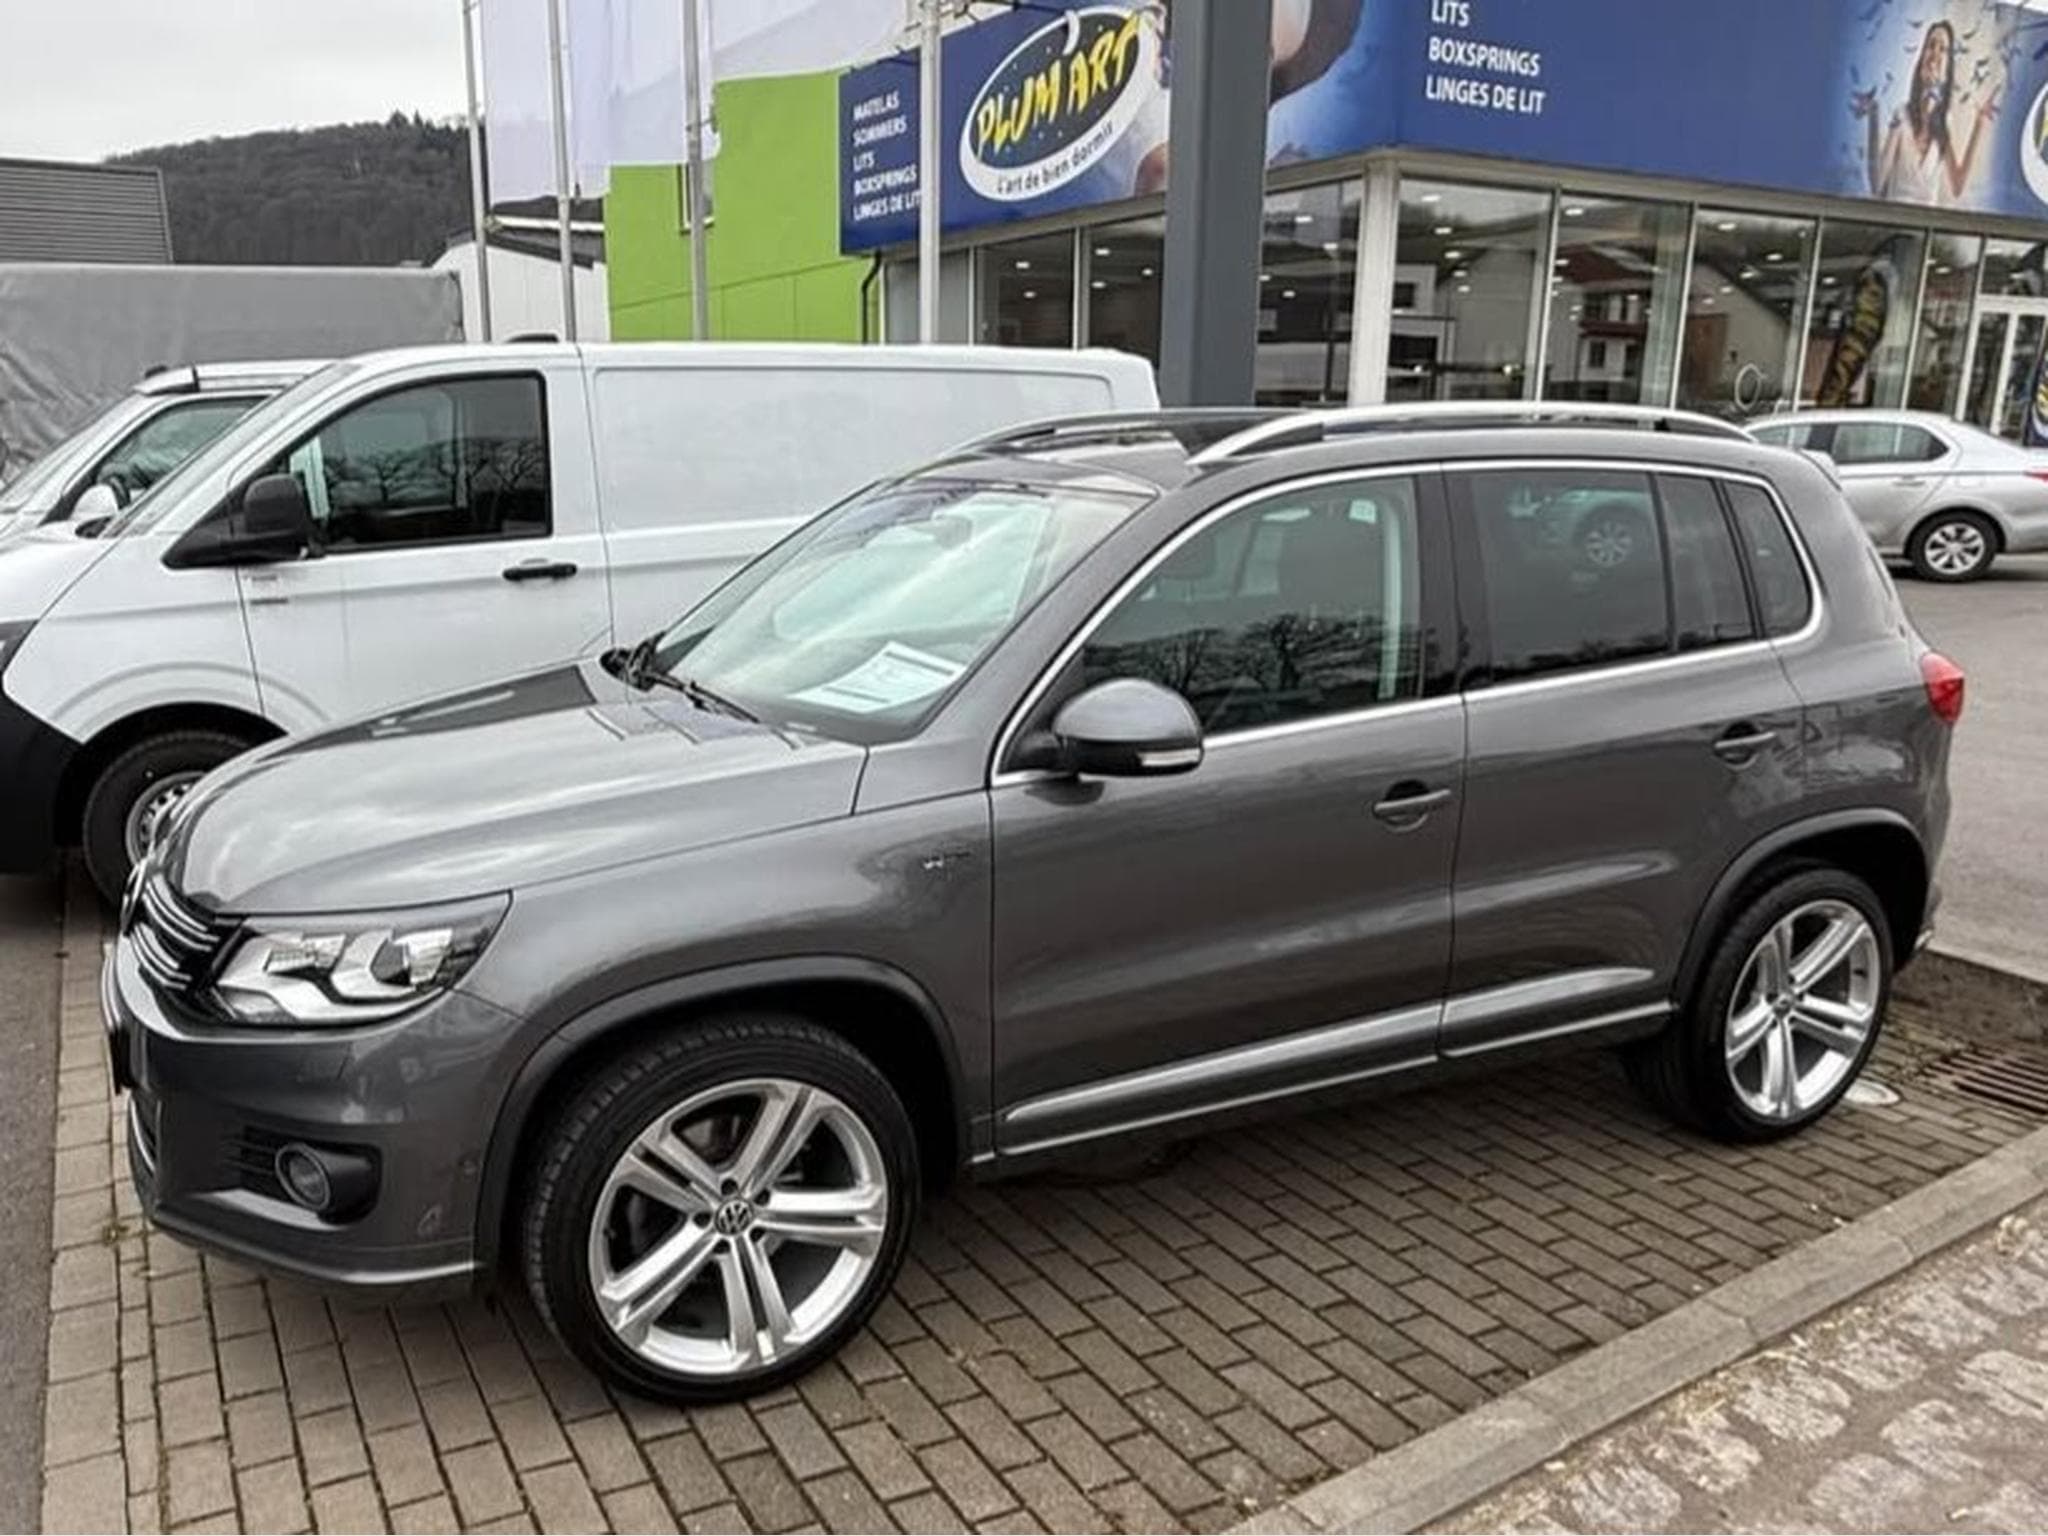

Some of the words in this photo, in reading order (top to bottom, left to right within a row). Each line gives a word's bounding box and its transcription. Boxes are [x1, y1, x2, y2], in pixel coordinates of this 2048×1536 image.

[1431, 0, 1470, 27] LITS
[1428, 36, 1541, 77] BOXSPRINGS
[853, 91, 900, 121] MATELAS
[1426, 75, 1489, 107] LINGES
[1491, 85, 1516, 111] DE
[1519, 91, 1546, 115] LIT
[853, 151, 875, 172] LITS
[1025, 171, 1040, 190] de
[1041, 159, 1070, 184] bien
[854, 164, 917, 197] BOXSPRINGS
[853, 197, 888, 221] LINGES
[889, 193, 903, 214] DE
